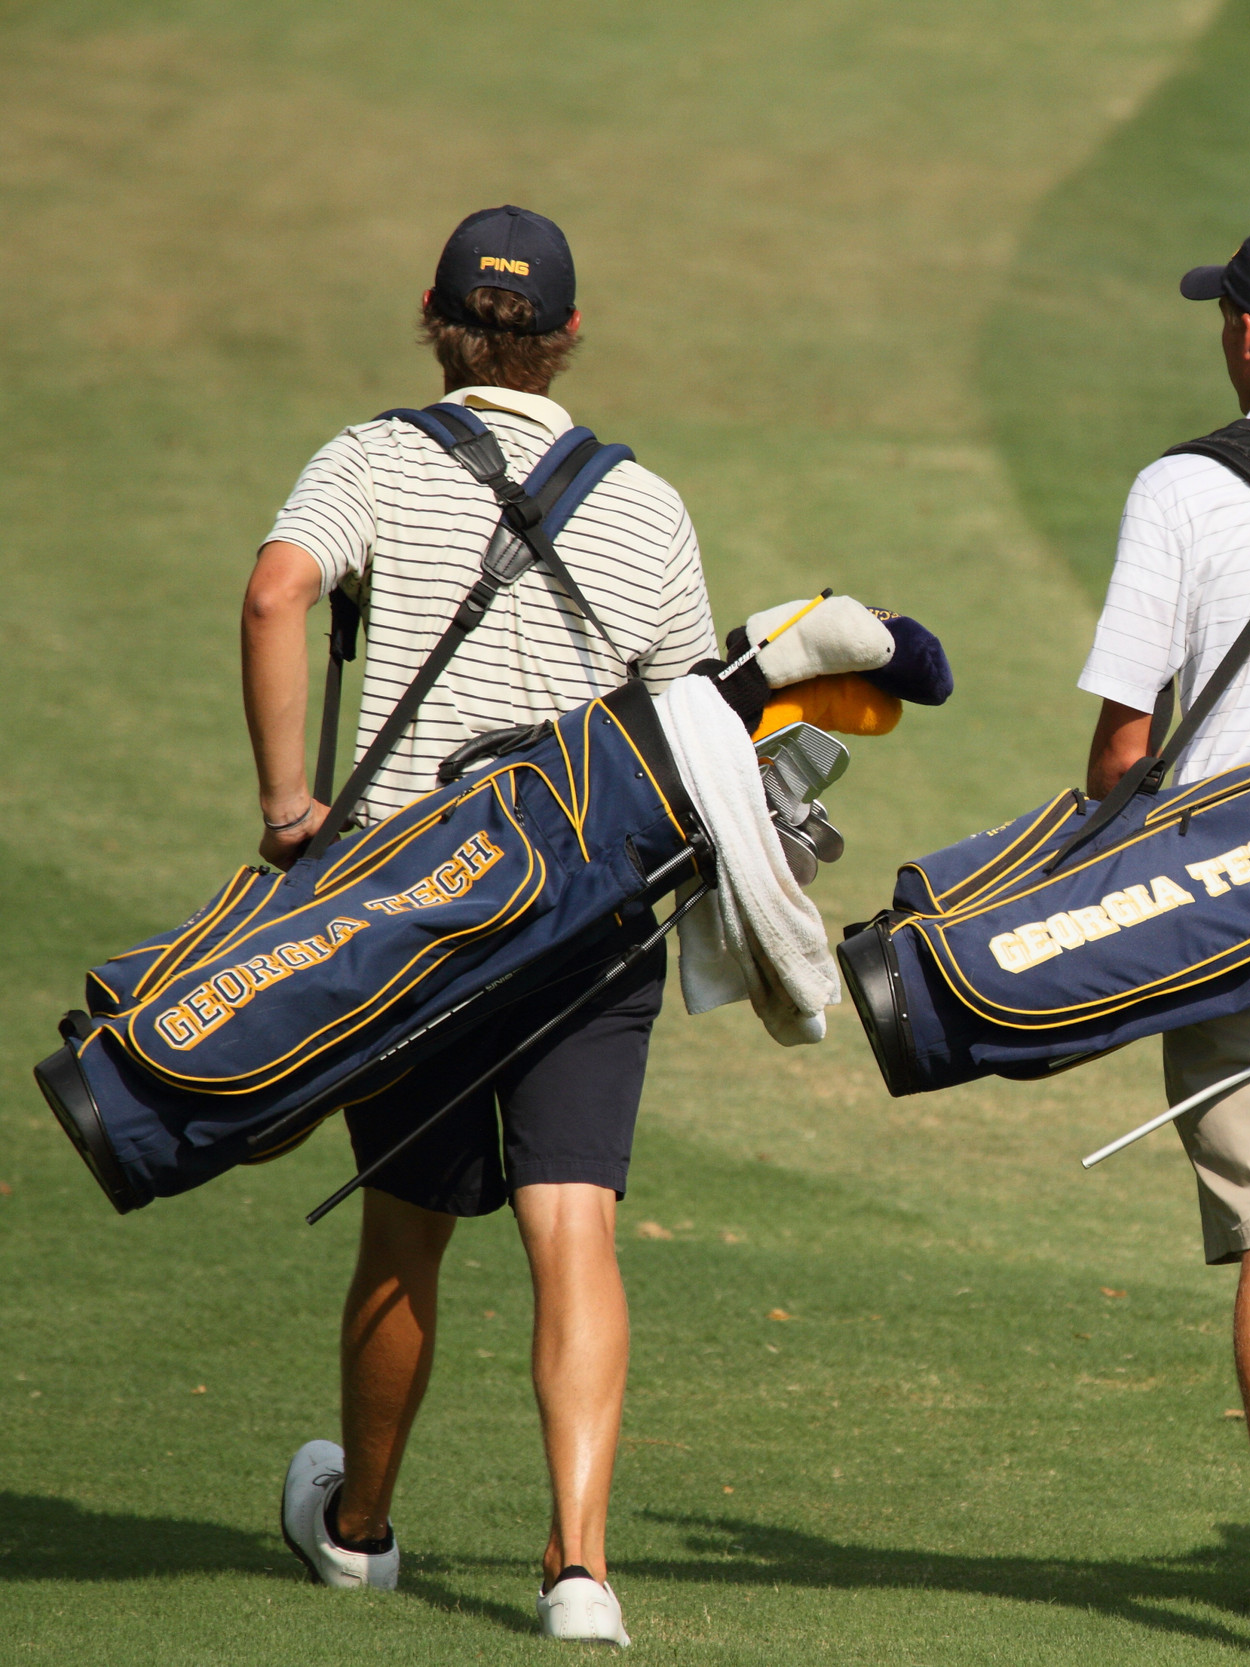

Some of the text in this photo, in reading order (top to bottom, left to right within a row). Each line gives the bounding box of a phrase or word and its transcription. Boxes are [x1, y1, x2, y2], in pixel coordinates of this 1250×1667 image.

[480, 256, 530, 276] PING
[154, 830, 505, 1051] GEORGIA TECH
[989, 875, 1195, 974] GEORGIA
